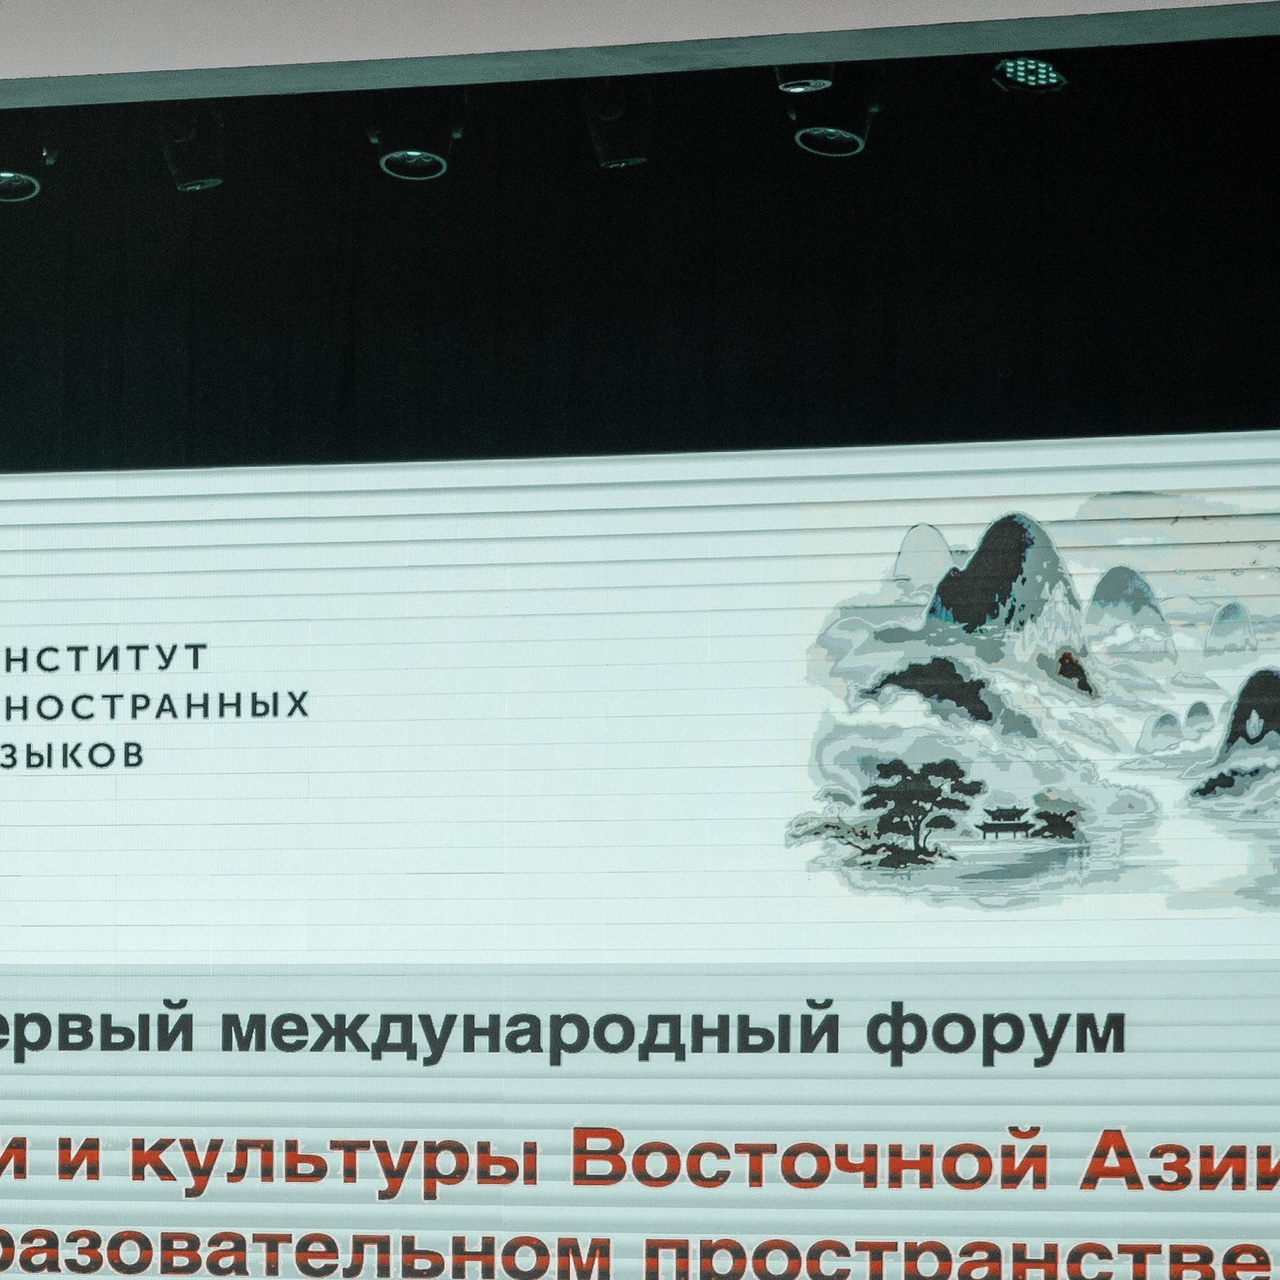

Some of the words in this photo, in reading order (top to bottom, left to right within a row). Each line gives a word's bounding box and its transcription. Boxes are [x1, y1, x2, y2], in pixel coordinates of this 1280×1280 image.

[220, 999, 840, 1066] международный
[867, 1001, 1126, 1067] форум
[57, 1136, 101, 1180] и
[130, 1137, 538, 1200] культуры
[572, 1125, 1049, 1190] Восточной
